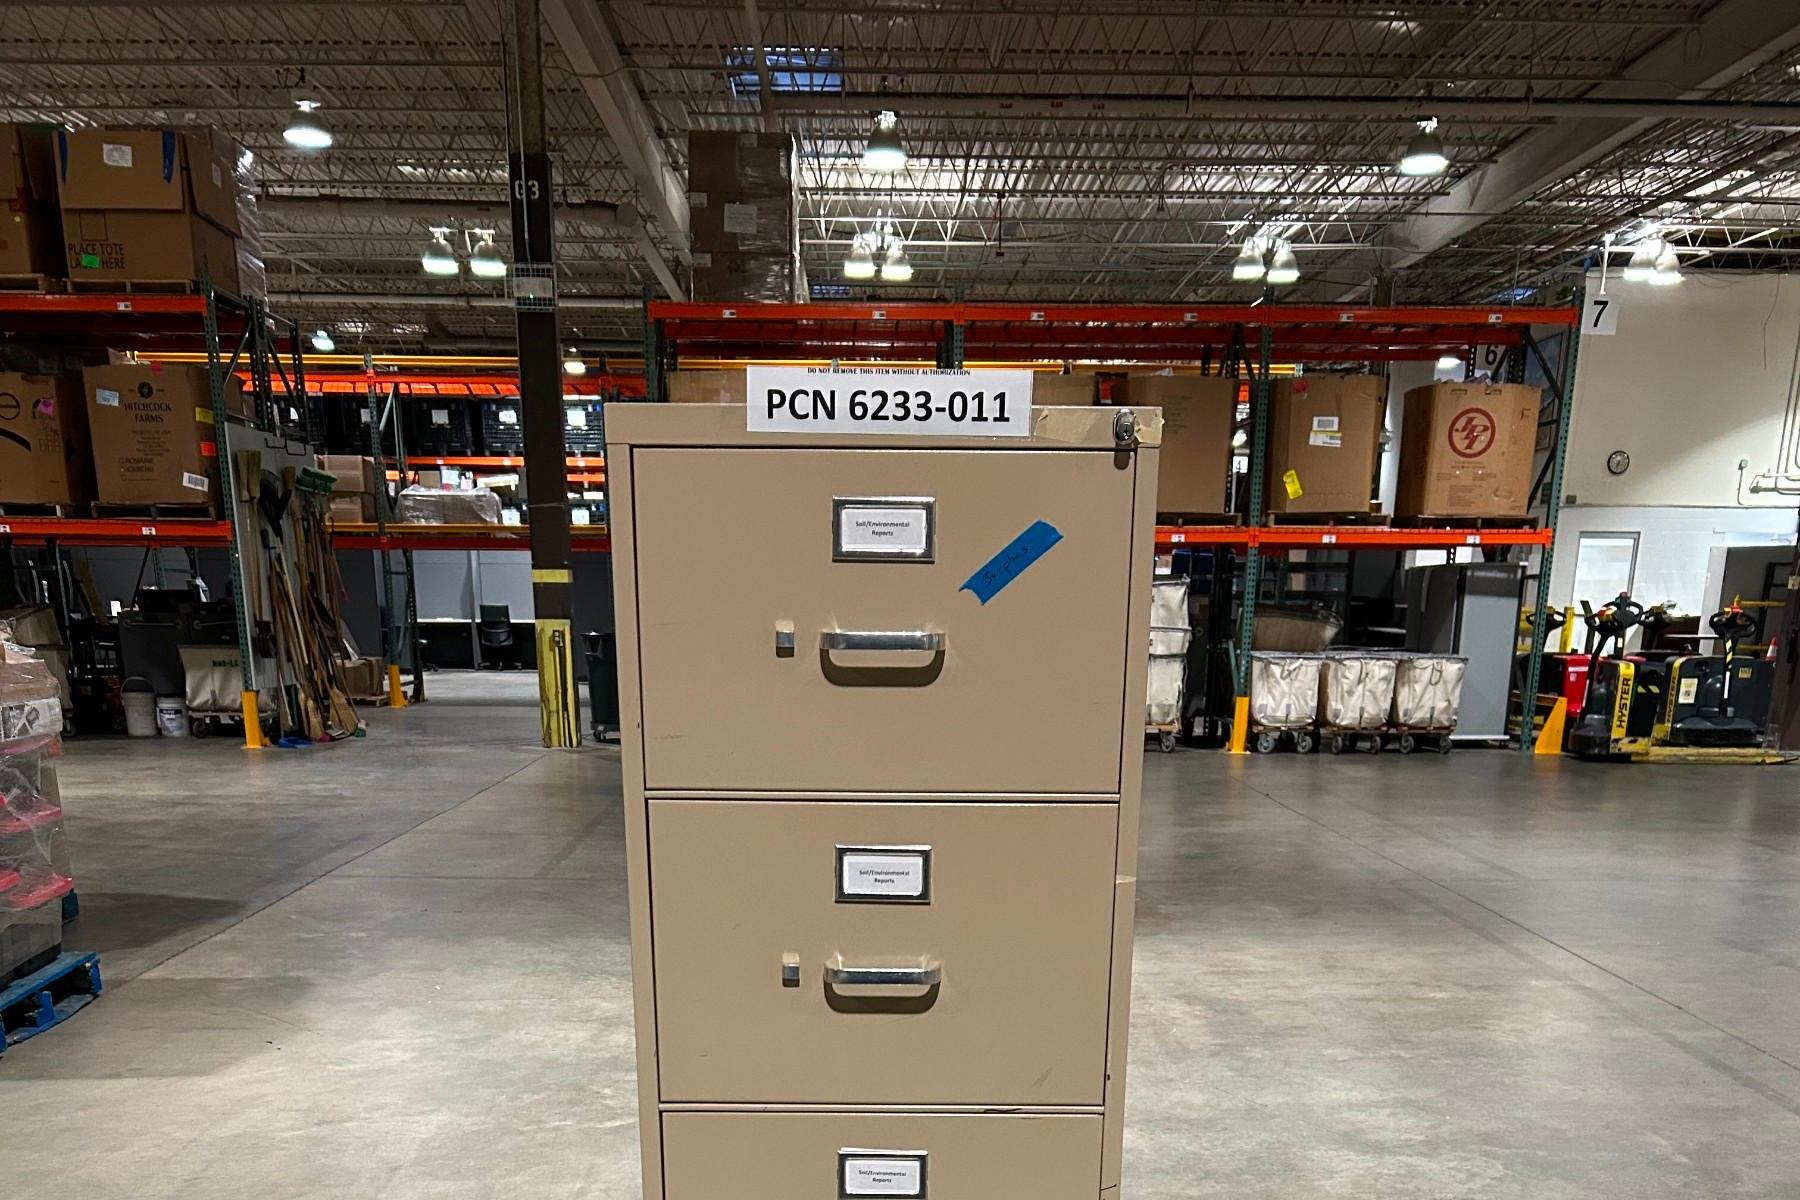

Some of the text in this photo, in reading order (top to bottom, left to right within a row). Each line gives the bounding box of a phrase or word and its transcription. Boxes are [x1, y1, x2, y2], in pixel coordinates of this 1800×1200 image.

[68, 243, 125, 256] PLACE TOTE
[102, 257, 126, 270] HERE
[1593, 300, 1609, 328] 7
[1485, 344, 1498, 366] 6
[921, 368, 971, 376] AUTHORIZATION
[124, 402, 172, 412] HITCHCOCK
[767, 389, 1010, 422] PCN 6233-011
[135, 413, 164, 423] FARMS
[855, 520, 910, 528] Soil/Environmental
[871, 529, 894, 537] Reports
[1616, 677, 1632, 729] HYSTER
